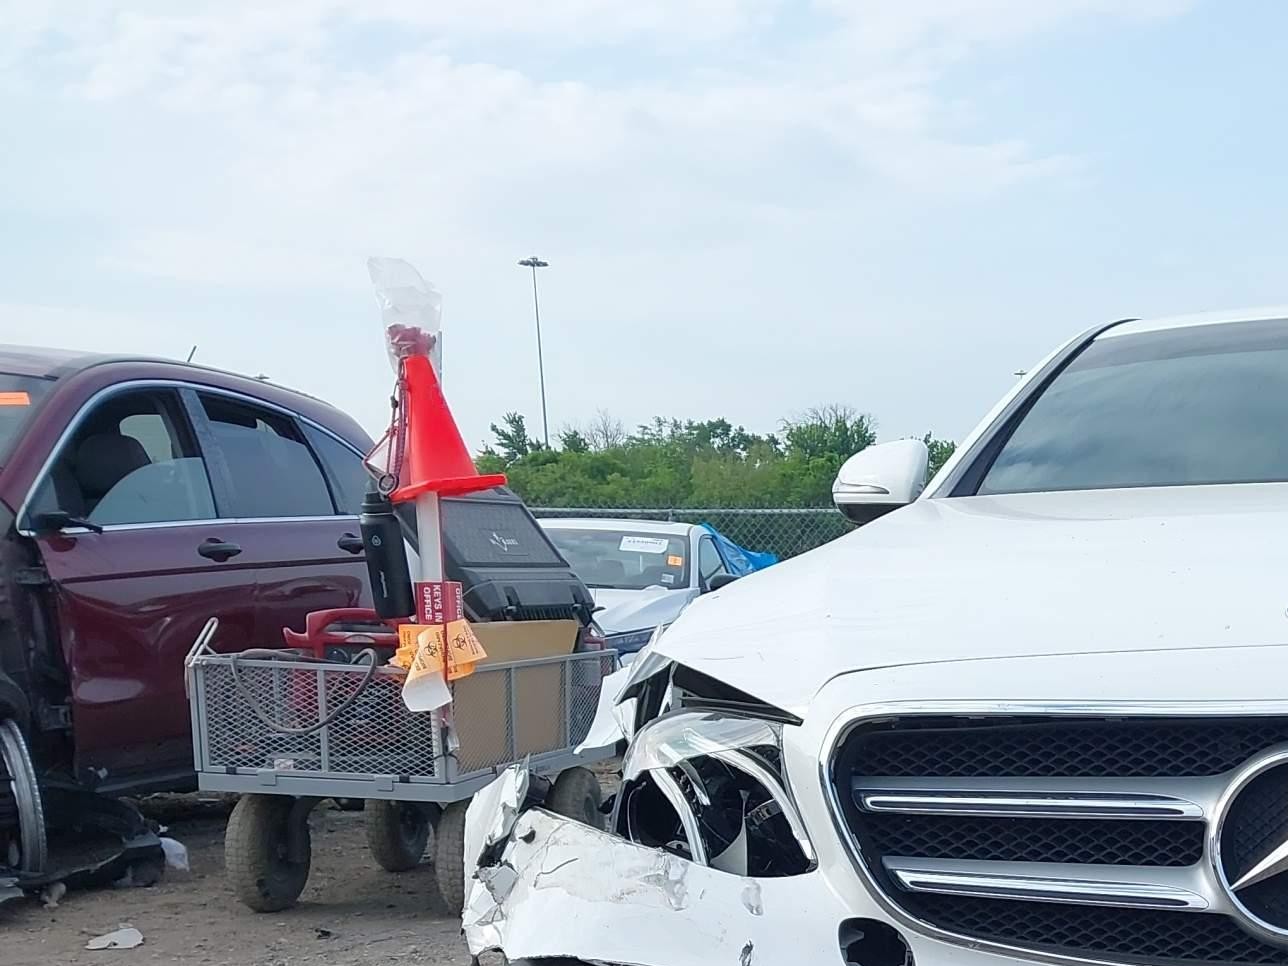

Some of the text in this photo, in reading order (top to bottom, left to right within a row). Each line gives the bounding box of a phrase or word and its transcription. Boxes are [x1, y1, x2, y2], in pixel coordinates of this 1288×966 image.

[423, 586, 433, 621] OFFICE
[433, 584, 443, 610] KEYS
[435, 612, 443, 623] IN
